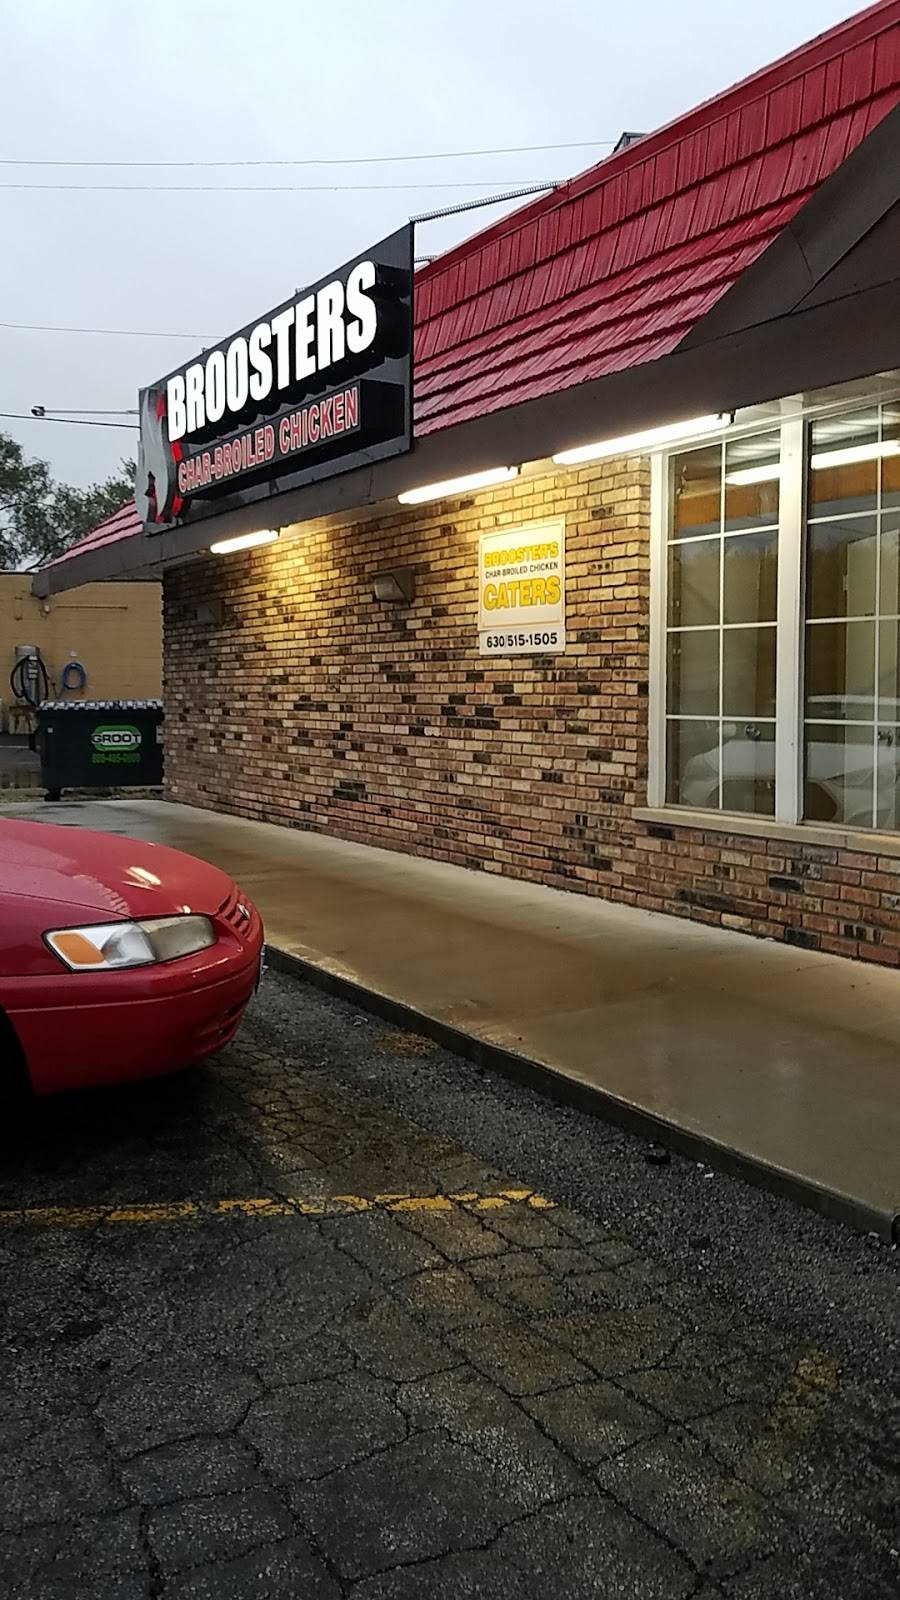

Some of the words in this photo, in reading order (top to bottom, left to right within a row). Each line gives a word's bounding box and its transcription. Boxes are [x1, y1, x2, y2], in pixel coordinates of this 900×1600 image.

[167, 260, 377, 442] BROOSTERS
[178, 425, 275, 493] CHAR-BROILED
[279, 387, 359, 454] CHICKEN
[529, 561, 559, 573] CHICKEN
[483, 575, 561, 611] CATERS
[486, 635, 505, 648] 630
[91, 734, 142, 743] GROOT
